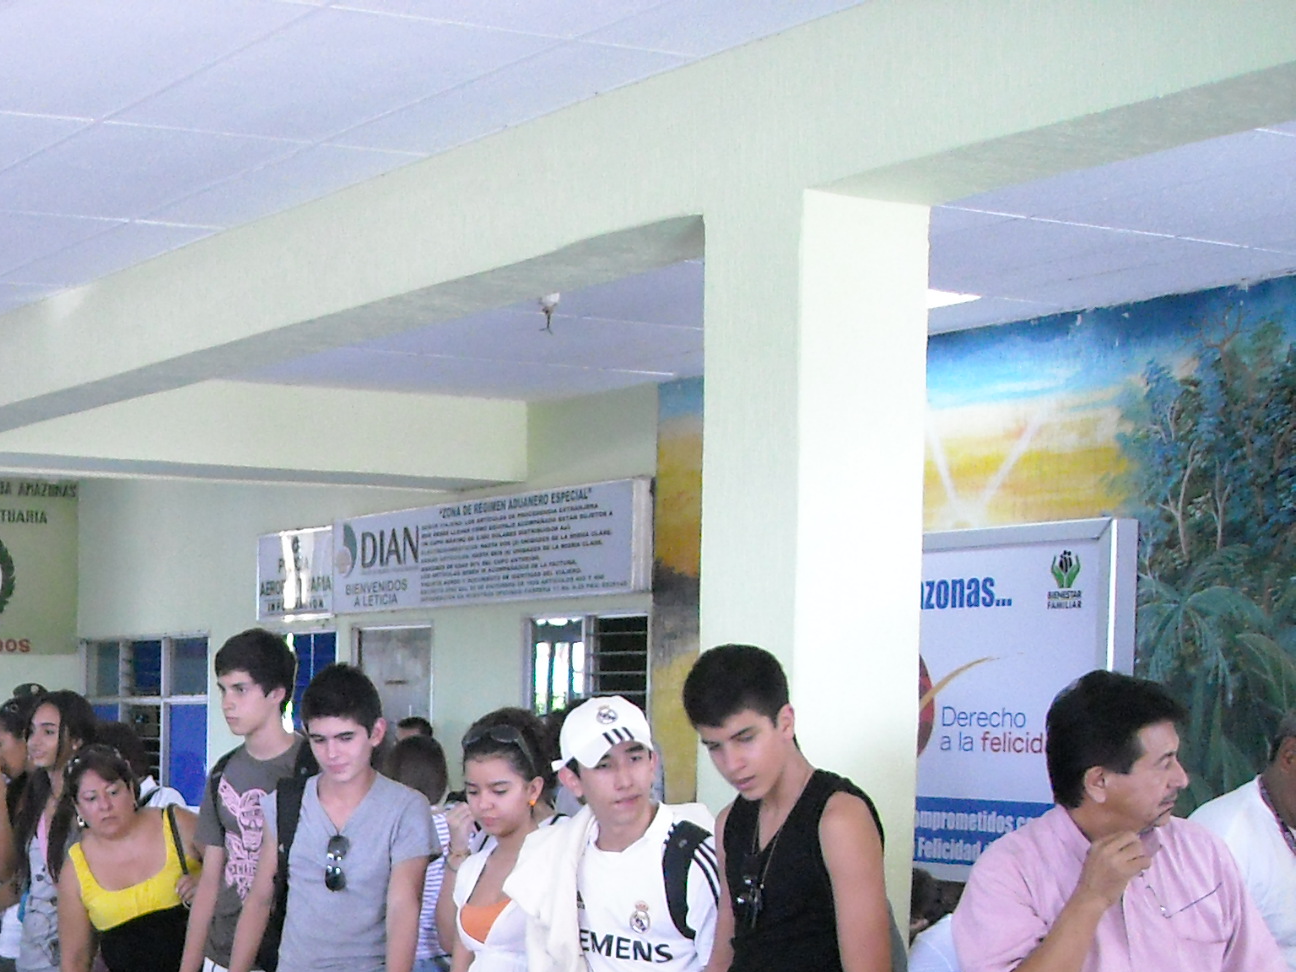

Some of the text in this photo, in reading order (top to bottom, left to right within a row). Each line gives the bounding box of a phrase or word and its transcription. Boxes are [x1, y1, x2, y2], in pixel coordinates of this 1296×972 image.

[361, 524, 419, 569] DIAN
[345, 579, 408, 595] BIENVENIDOS
[354, 593, 398, 607] A LETICIA
[1047, 600, 1082, 609] FAMILIAR
[942, 706, 1026, 729] Derecho
[940, 731, 1045, 754] a la felicid
[918, 838, 982, 861] Felicidad
[579, 929, 673, 963] EMENS
